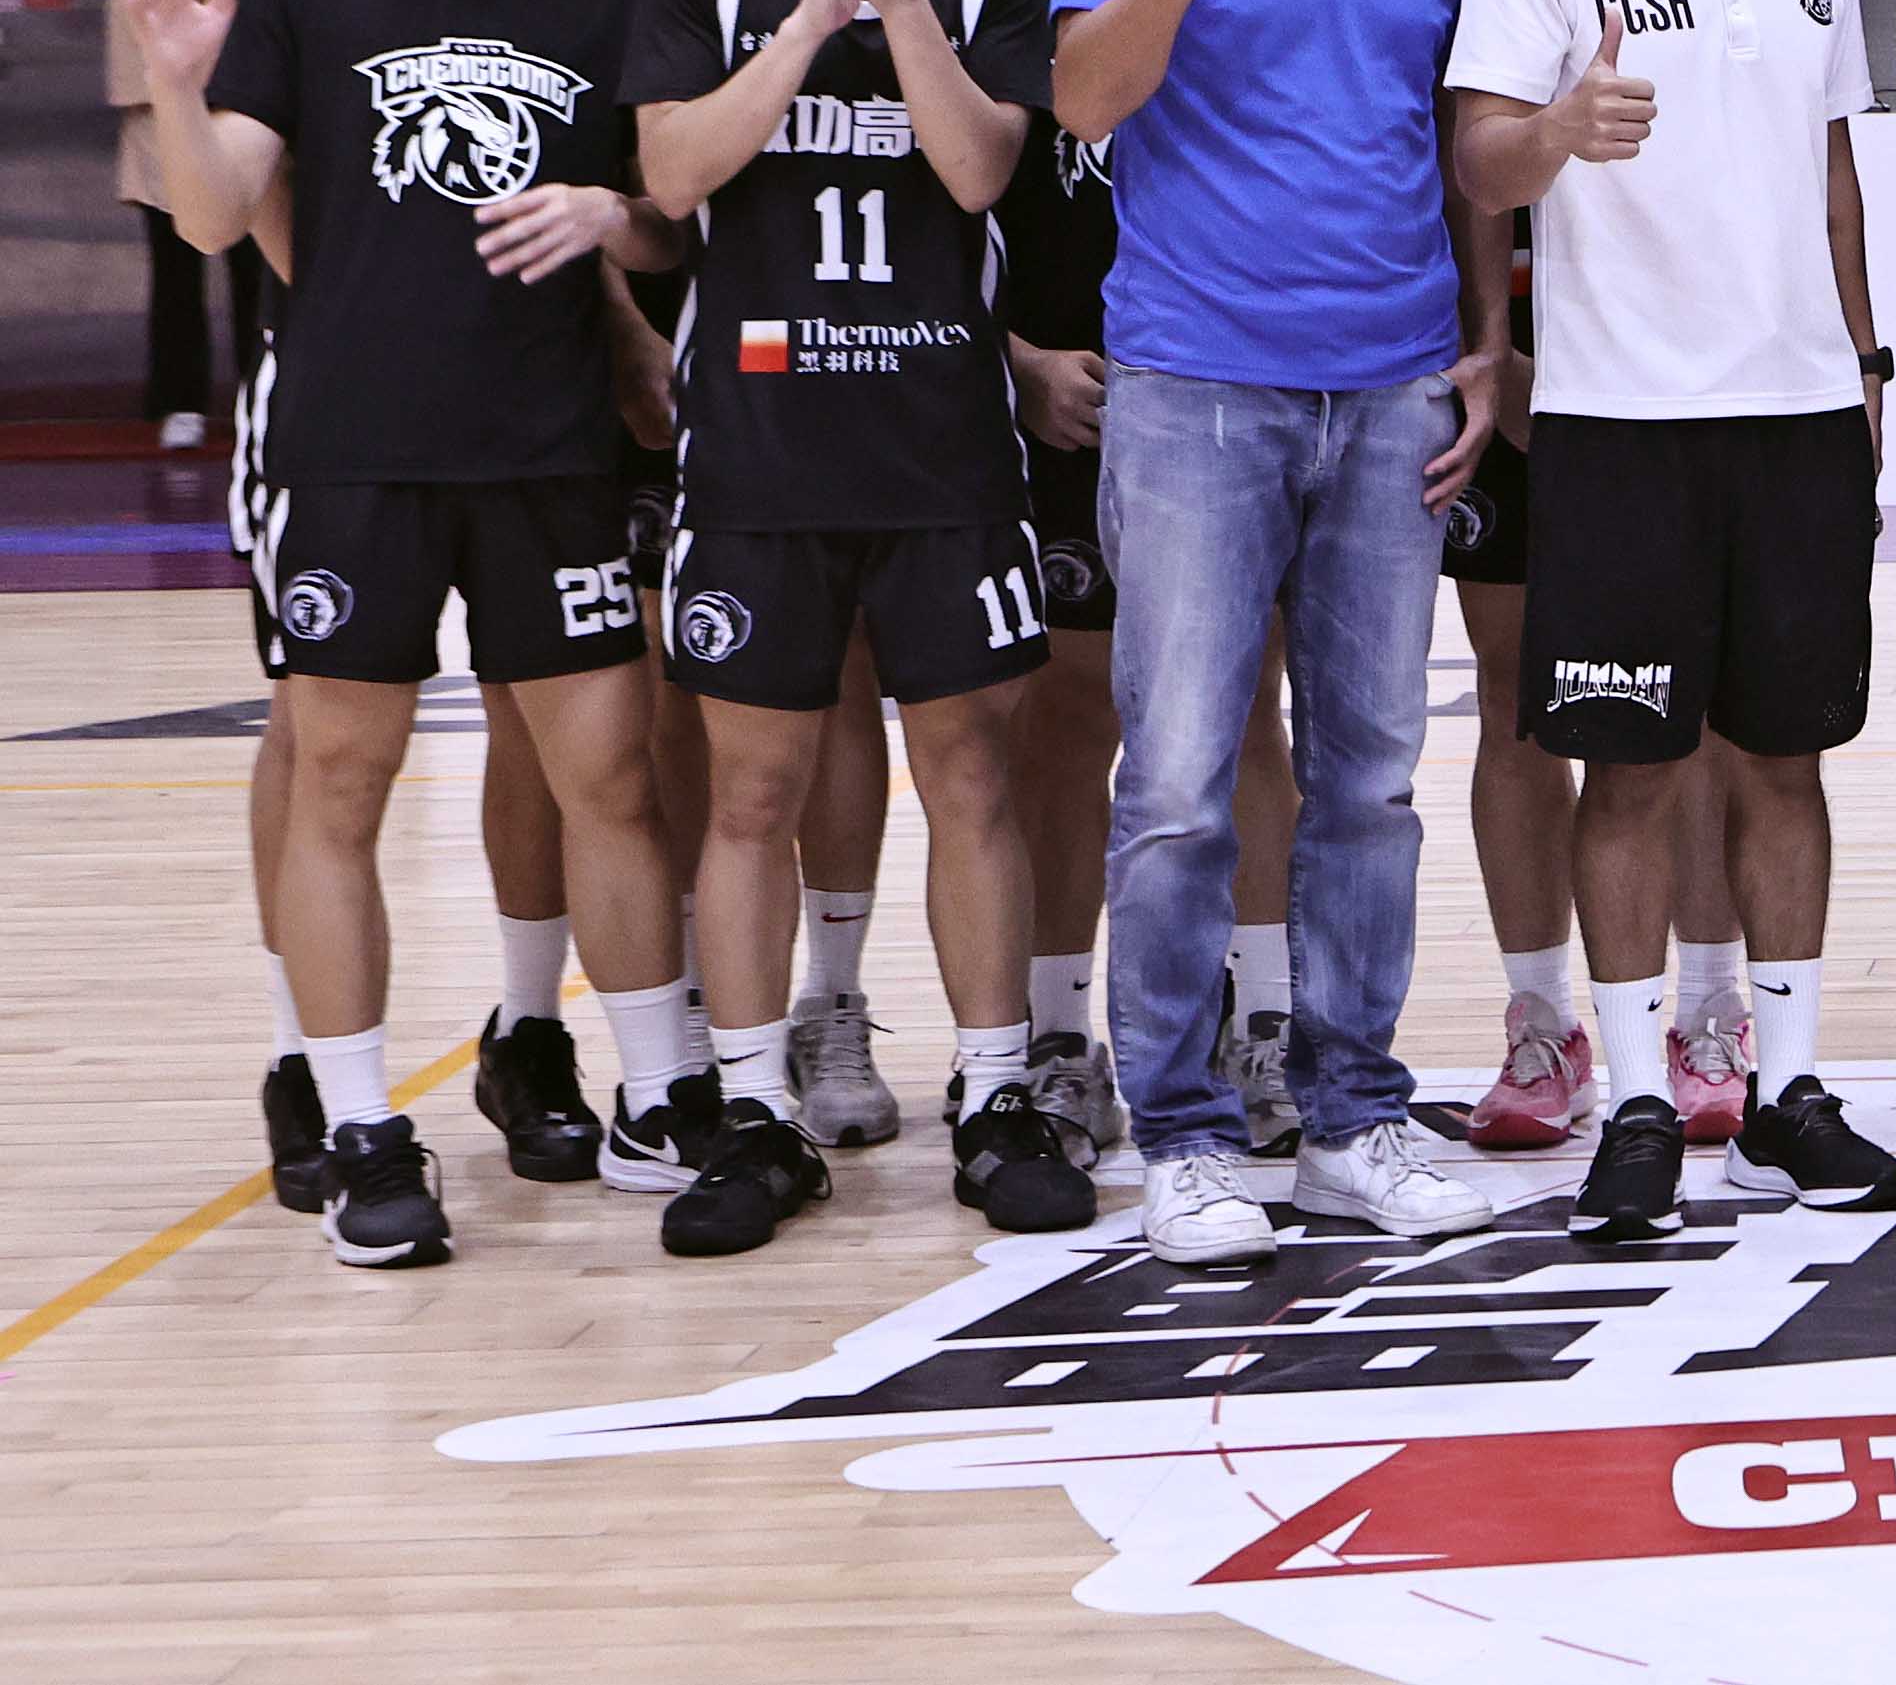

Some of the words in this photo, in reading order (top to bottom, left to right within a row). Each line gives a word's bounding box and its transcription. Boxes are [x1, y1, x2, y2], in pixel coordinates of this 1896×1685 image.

[814, 186, 893, 282] 11
[553, 555, 637, 637] 25
[976, 565, 1043, 650] 11
[1546, 660, 1672, 719] JORDAN
